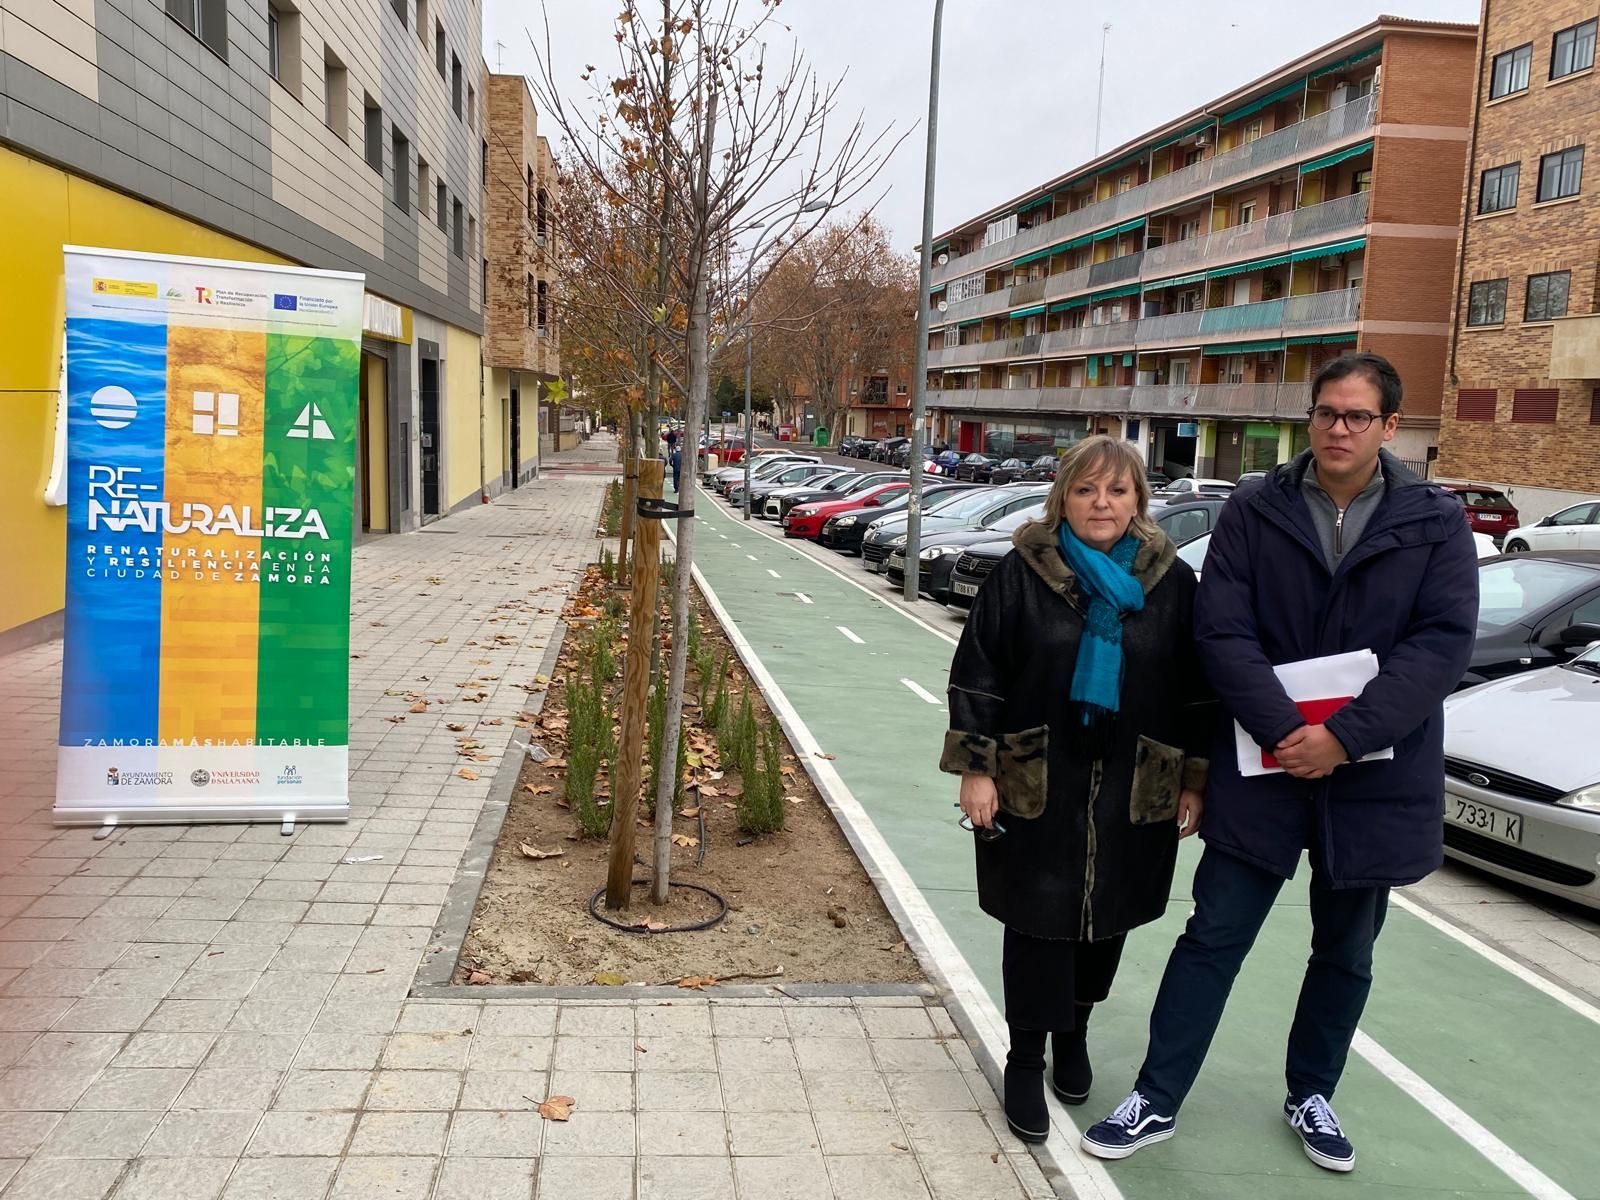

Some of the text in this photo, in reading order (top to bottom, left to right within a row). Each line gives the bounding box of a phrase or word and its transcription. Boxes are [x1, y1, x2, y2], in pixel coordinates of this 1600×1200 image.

[89, 465, 158, 499] RE-
[88, 499, 330, 540] NATURALIZA
[87, 544, 331, 563] RENATURALIZACIÓN
[87, 557, 330, 574] Y RESILIENCIA EN LA
[87, 568, 331, 585] CIUDAD DE ZAMORA
[1456, 800, 1518, 840] 7331 K
